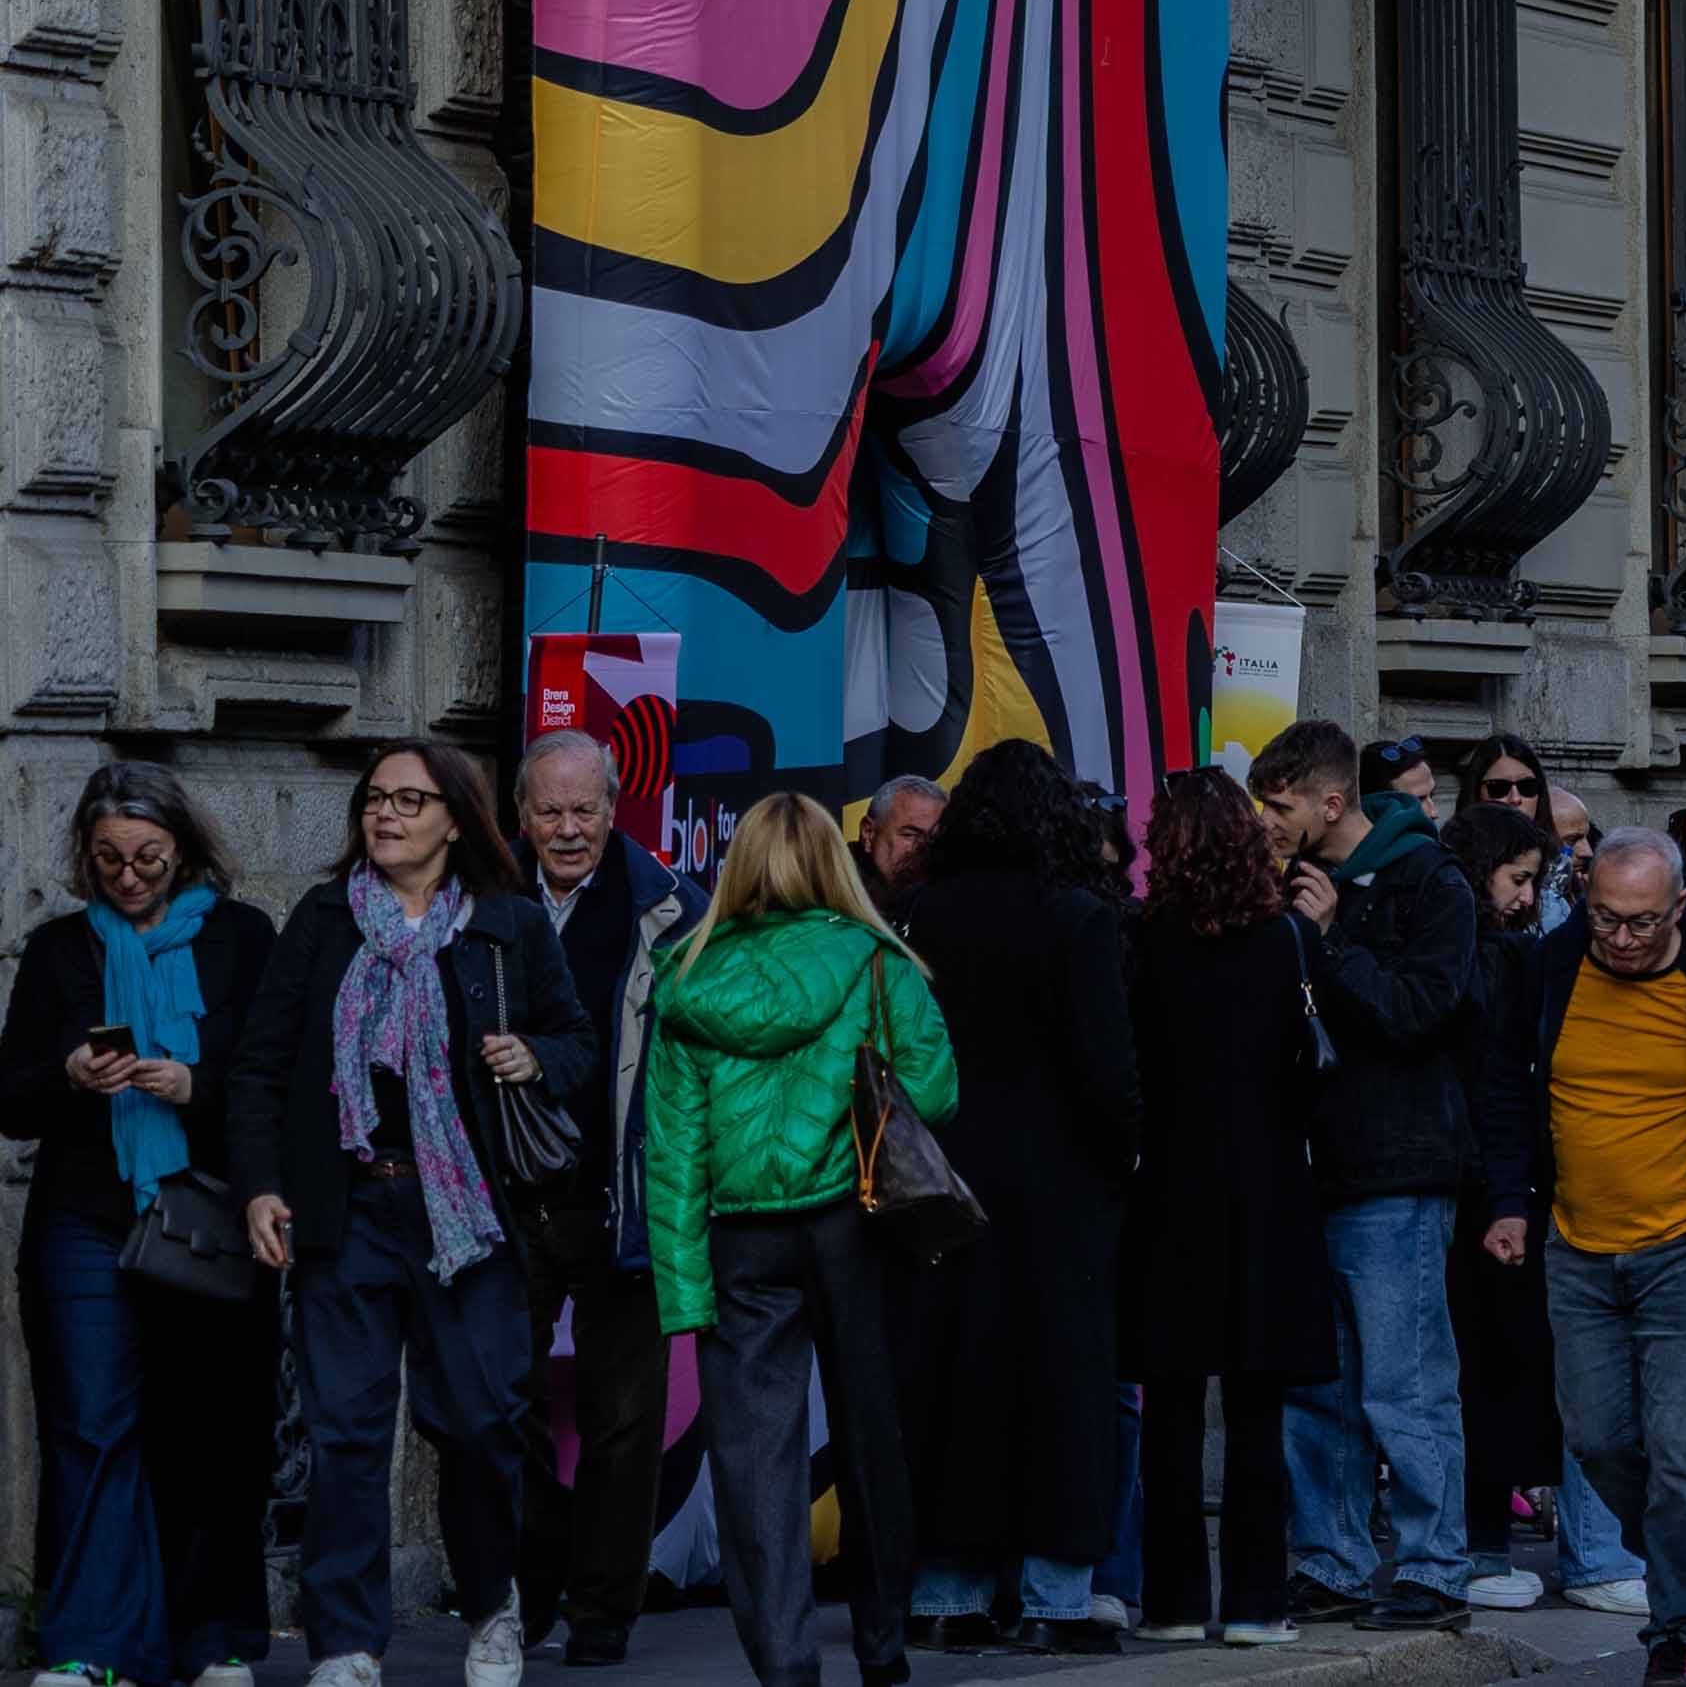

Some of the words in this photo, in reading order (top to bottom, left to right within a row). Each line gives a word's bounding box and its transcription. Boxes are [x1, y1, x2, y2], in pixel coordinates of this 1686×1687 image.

[1239, 658, 1279, 669] ITALIA
[543, 688, 569, 701] Brera
[543, 701, 576, 716] Design
[718, 803, 737, 841] for
